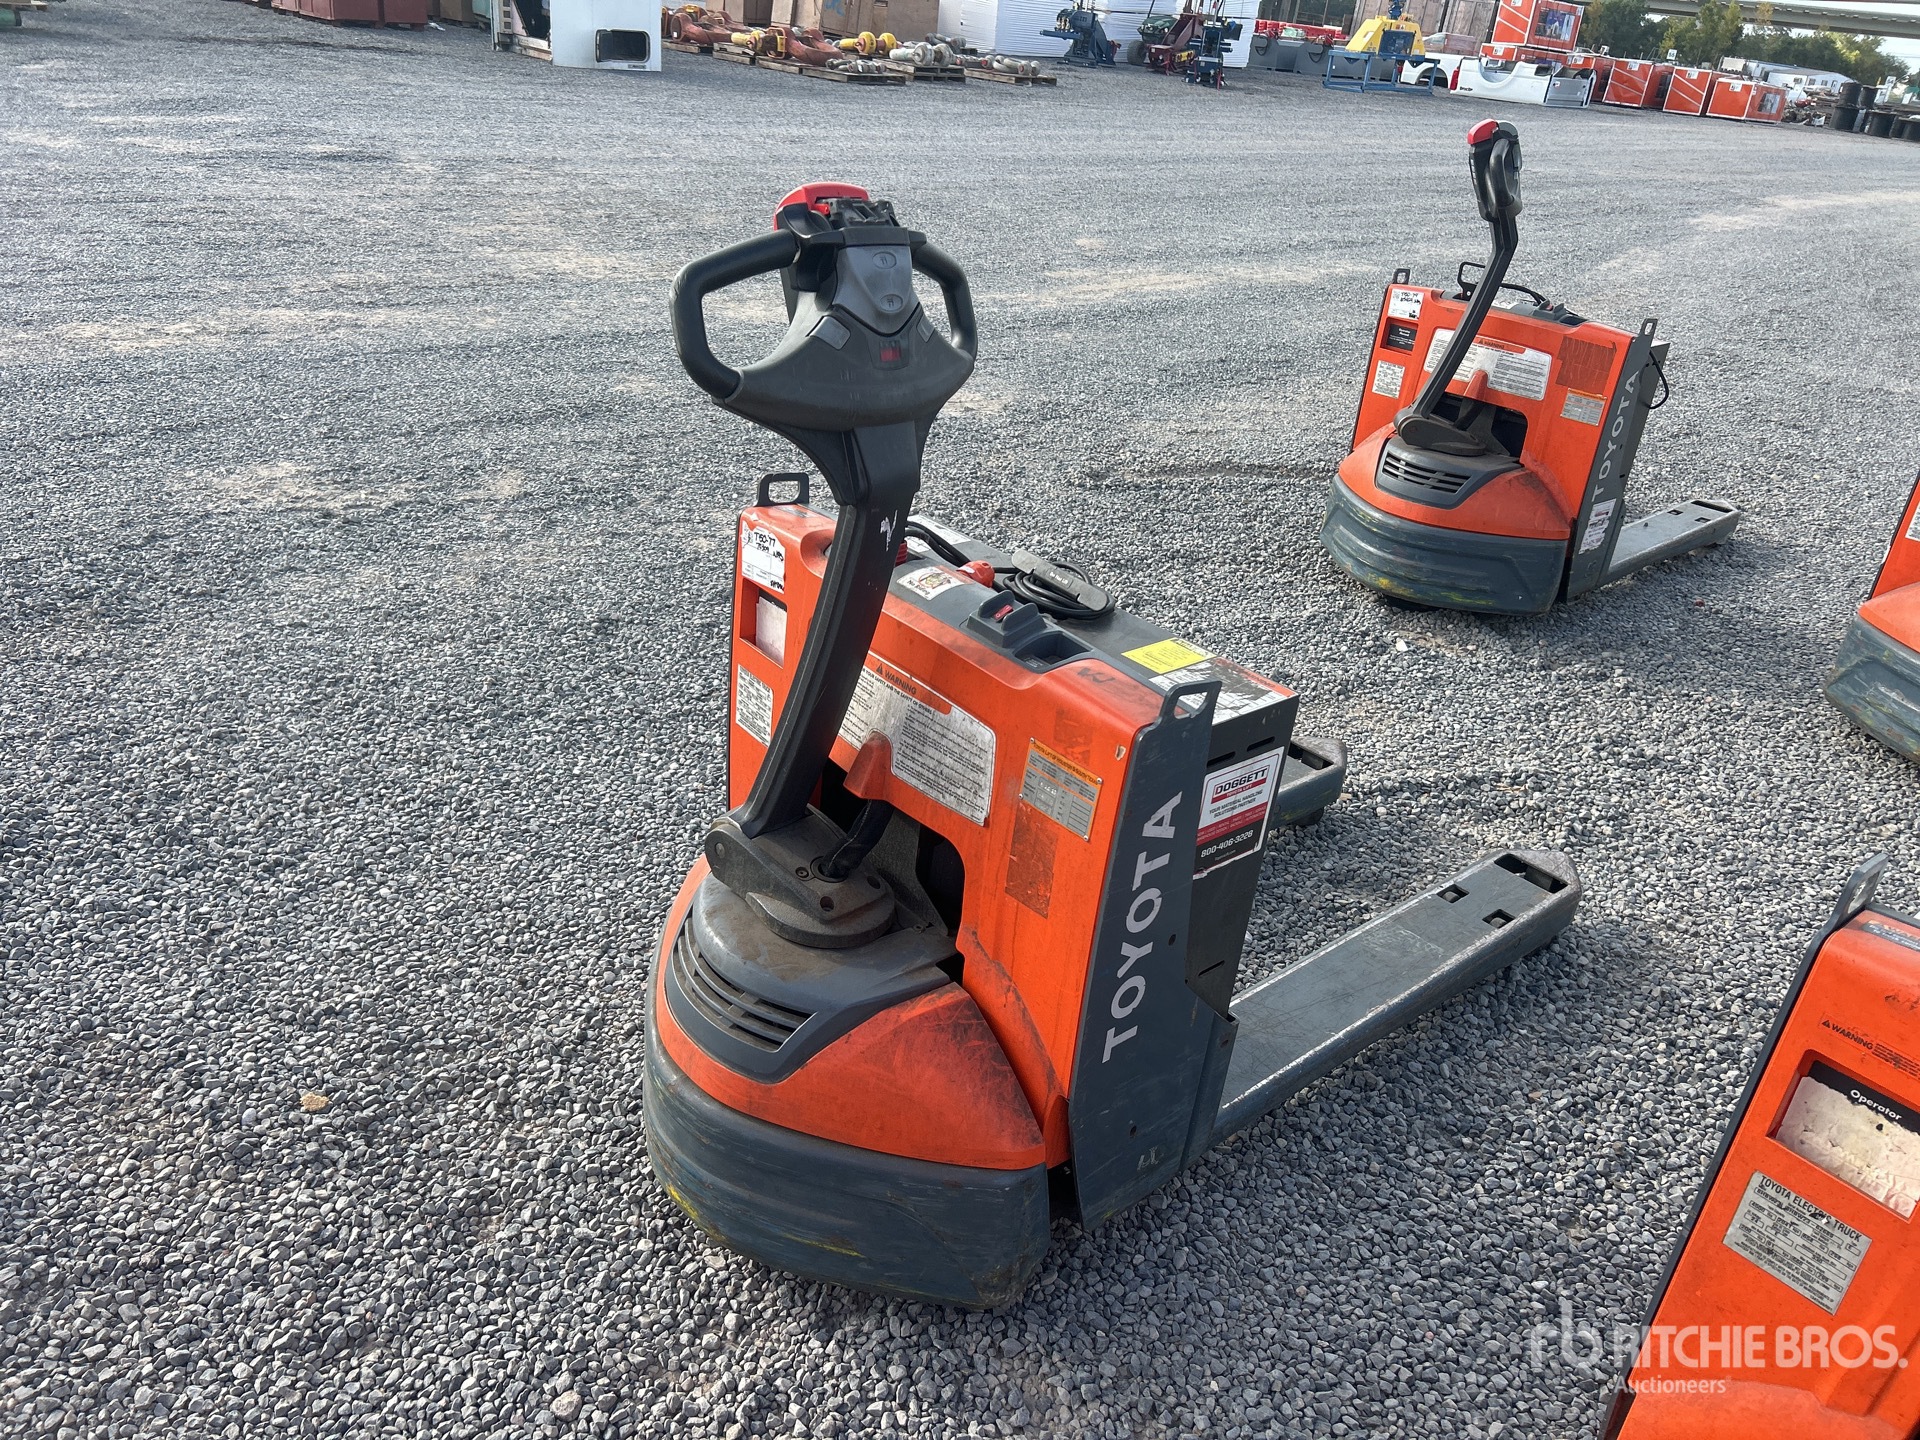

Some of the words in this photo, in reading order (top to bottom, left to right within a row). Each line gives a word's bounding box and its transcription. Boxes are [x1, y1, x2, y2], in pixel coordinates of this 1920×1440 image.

[1591, 370, 1639, 503] TOYOTA
[866, 670, 874, 679] YOUR
[875, 674, 886, 686] SAFETY
[886, 682, 894, 691] AND
[900, 692, 912, 702] SAFETY
[885, 669, 917, 696] WARNING
[1215, 767, 1267, 795] DOGGETT
[1210, 806, 1221, 814] YOUR
[1221, 799, 1241, 810] MATERIAL
[1201, 830, 1253, 858] 800-406-3228
[1102, 791, 1182, 1063] TOYOTA
[1832, 1023, 1873, 1050] WARNING
[1850, 1089, 1902, 1120] Operator
[1760, 1175, 1791, 1200] TOYOTA
[1833, 1219, 1862, 1242] TRUCK
